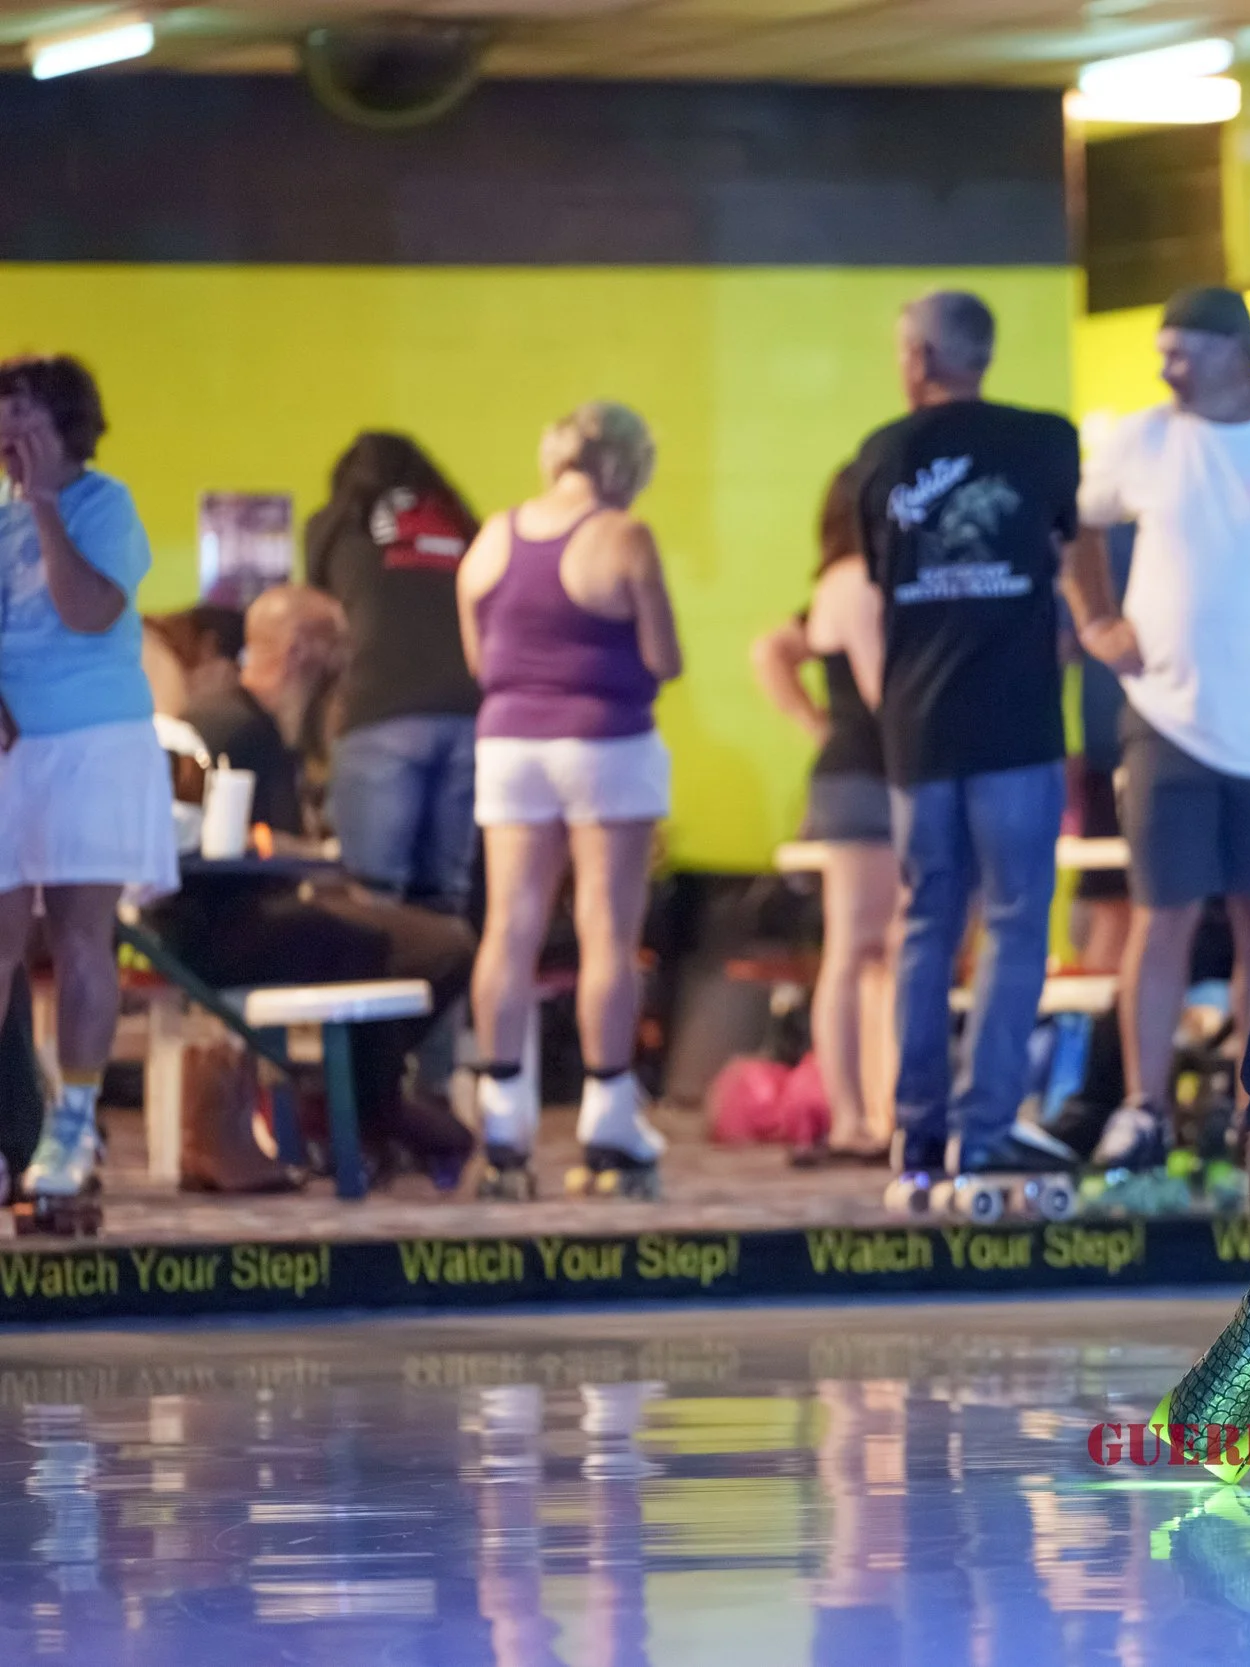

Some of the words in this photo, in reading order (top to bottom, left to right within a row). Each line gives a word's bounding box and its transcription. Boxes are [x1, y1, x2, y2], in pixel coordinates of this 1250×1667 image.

[1, 1251, 118, 1298] Watch
[131, 1248, 221, 1292] Your
[231, 1245, 330, 1299] Step!
[400, 1239, 524, 1284] Watch
[536, 1236, 626, 1280] Your
[636, 1233, 739, 1286] Step!
[806, 1230, 933, 1274] Watch
[943, 1226, 1031, 1269] Your
[1043, 1222, 1145, 1274] Step!
